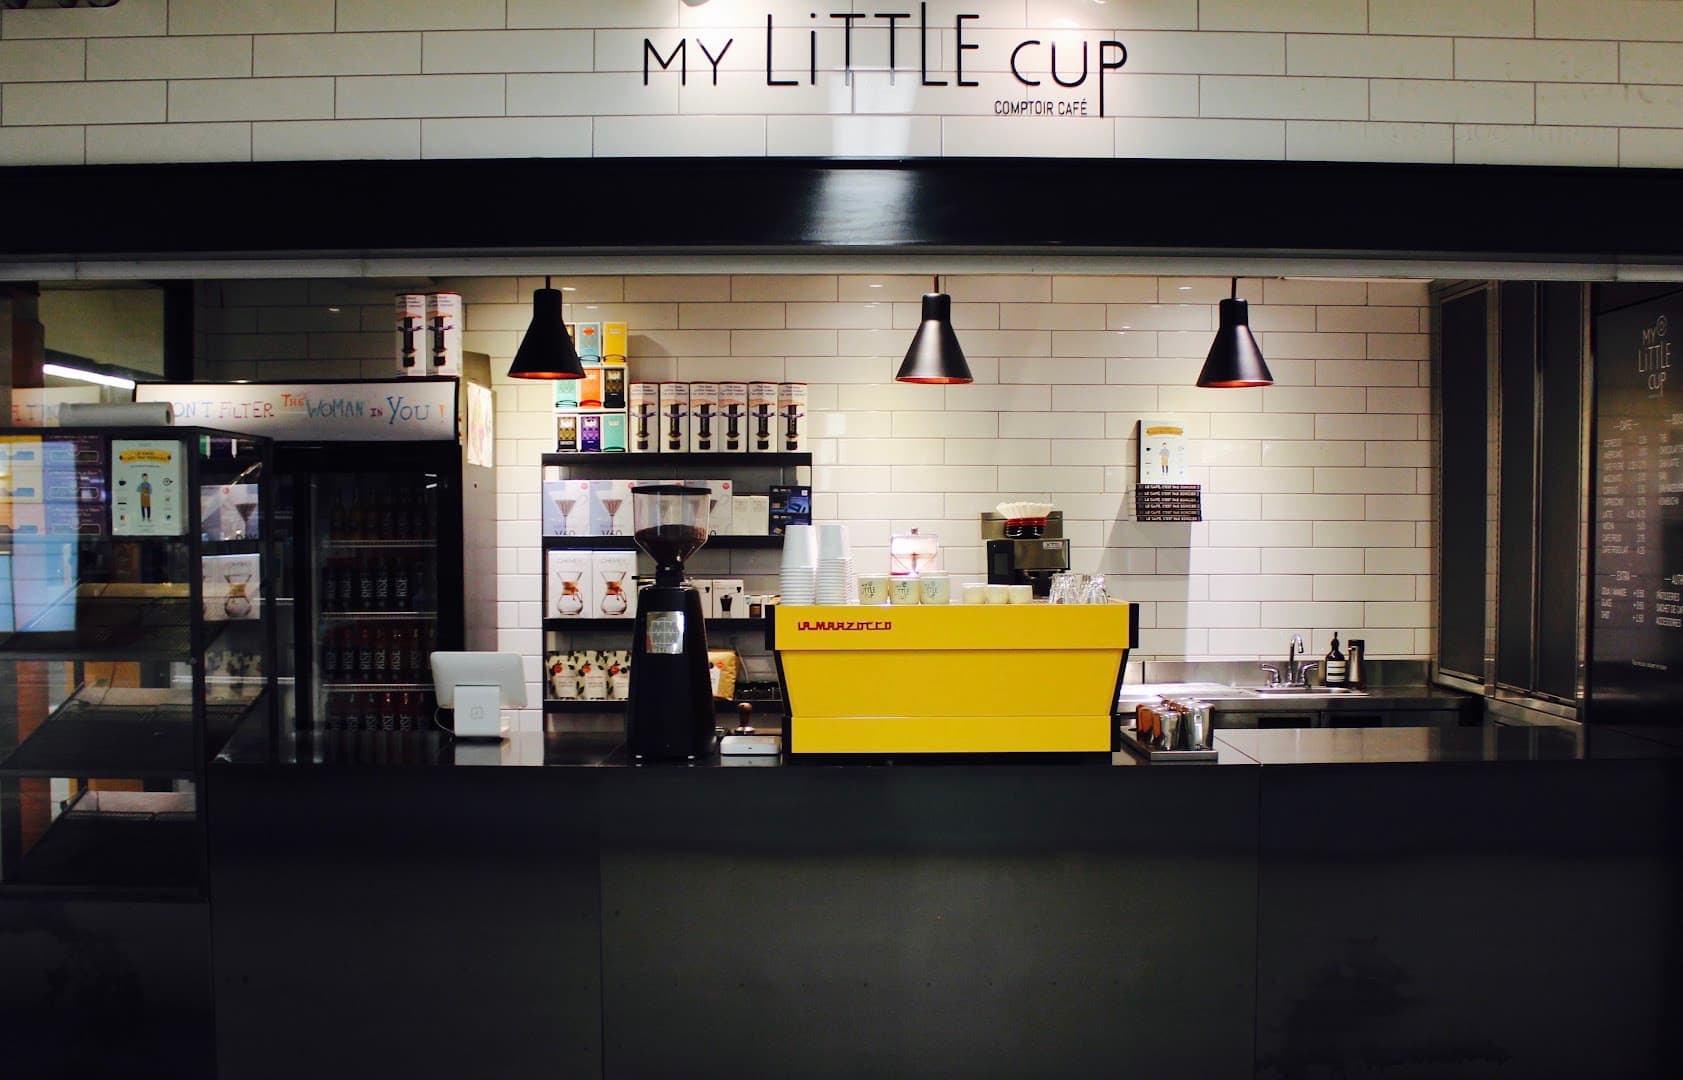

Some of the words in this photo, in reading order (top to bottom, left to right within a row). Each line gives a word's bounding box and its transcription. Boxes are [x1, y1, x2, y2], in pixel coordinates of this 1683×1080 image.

[643, 37, 734, 87] MY
[1010, 39, 1129, 119] CUP
[994, 101, 1054, 116] COMPTOIR
[1058, 98, 1088, 116] CAFÉ
[305, 399, 364, 418] WOMAN
[370, 407, 383, 417] IN
